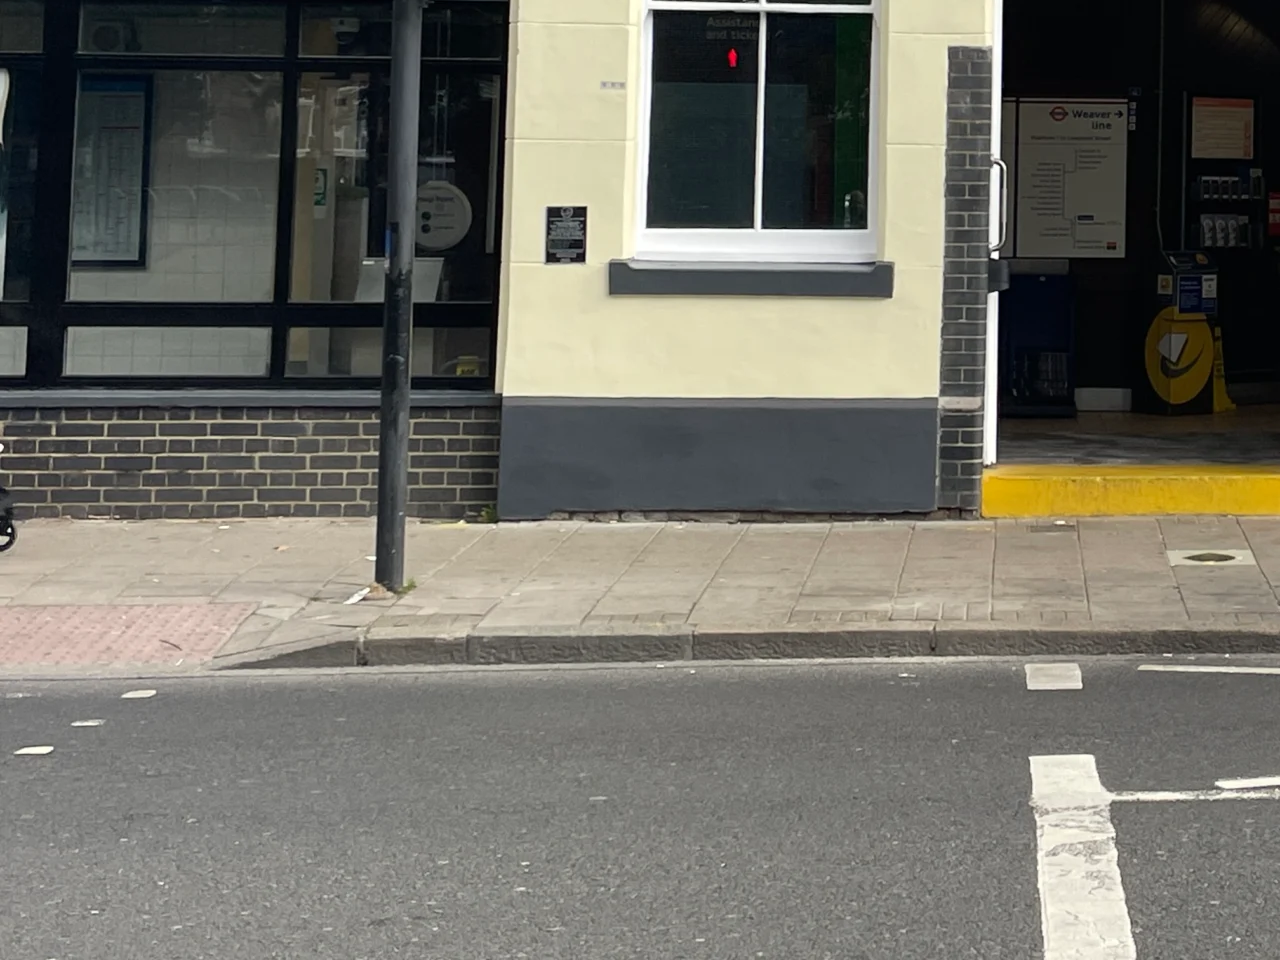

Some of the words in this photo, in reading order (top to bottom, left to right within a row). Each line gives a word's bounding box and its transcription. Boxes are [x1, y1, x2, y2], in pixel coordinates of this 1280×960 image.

[706, 16, 759, 28] Assistan
[1072, 109, 1112, 119] Weaver
[1091, 120, 1112, 130] line
